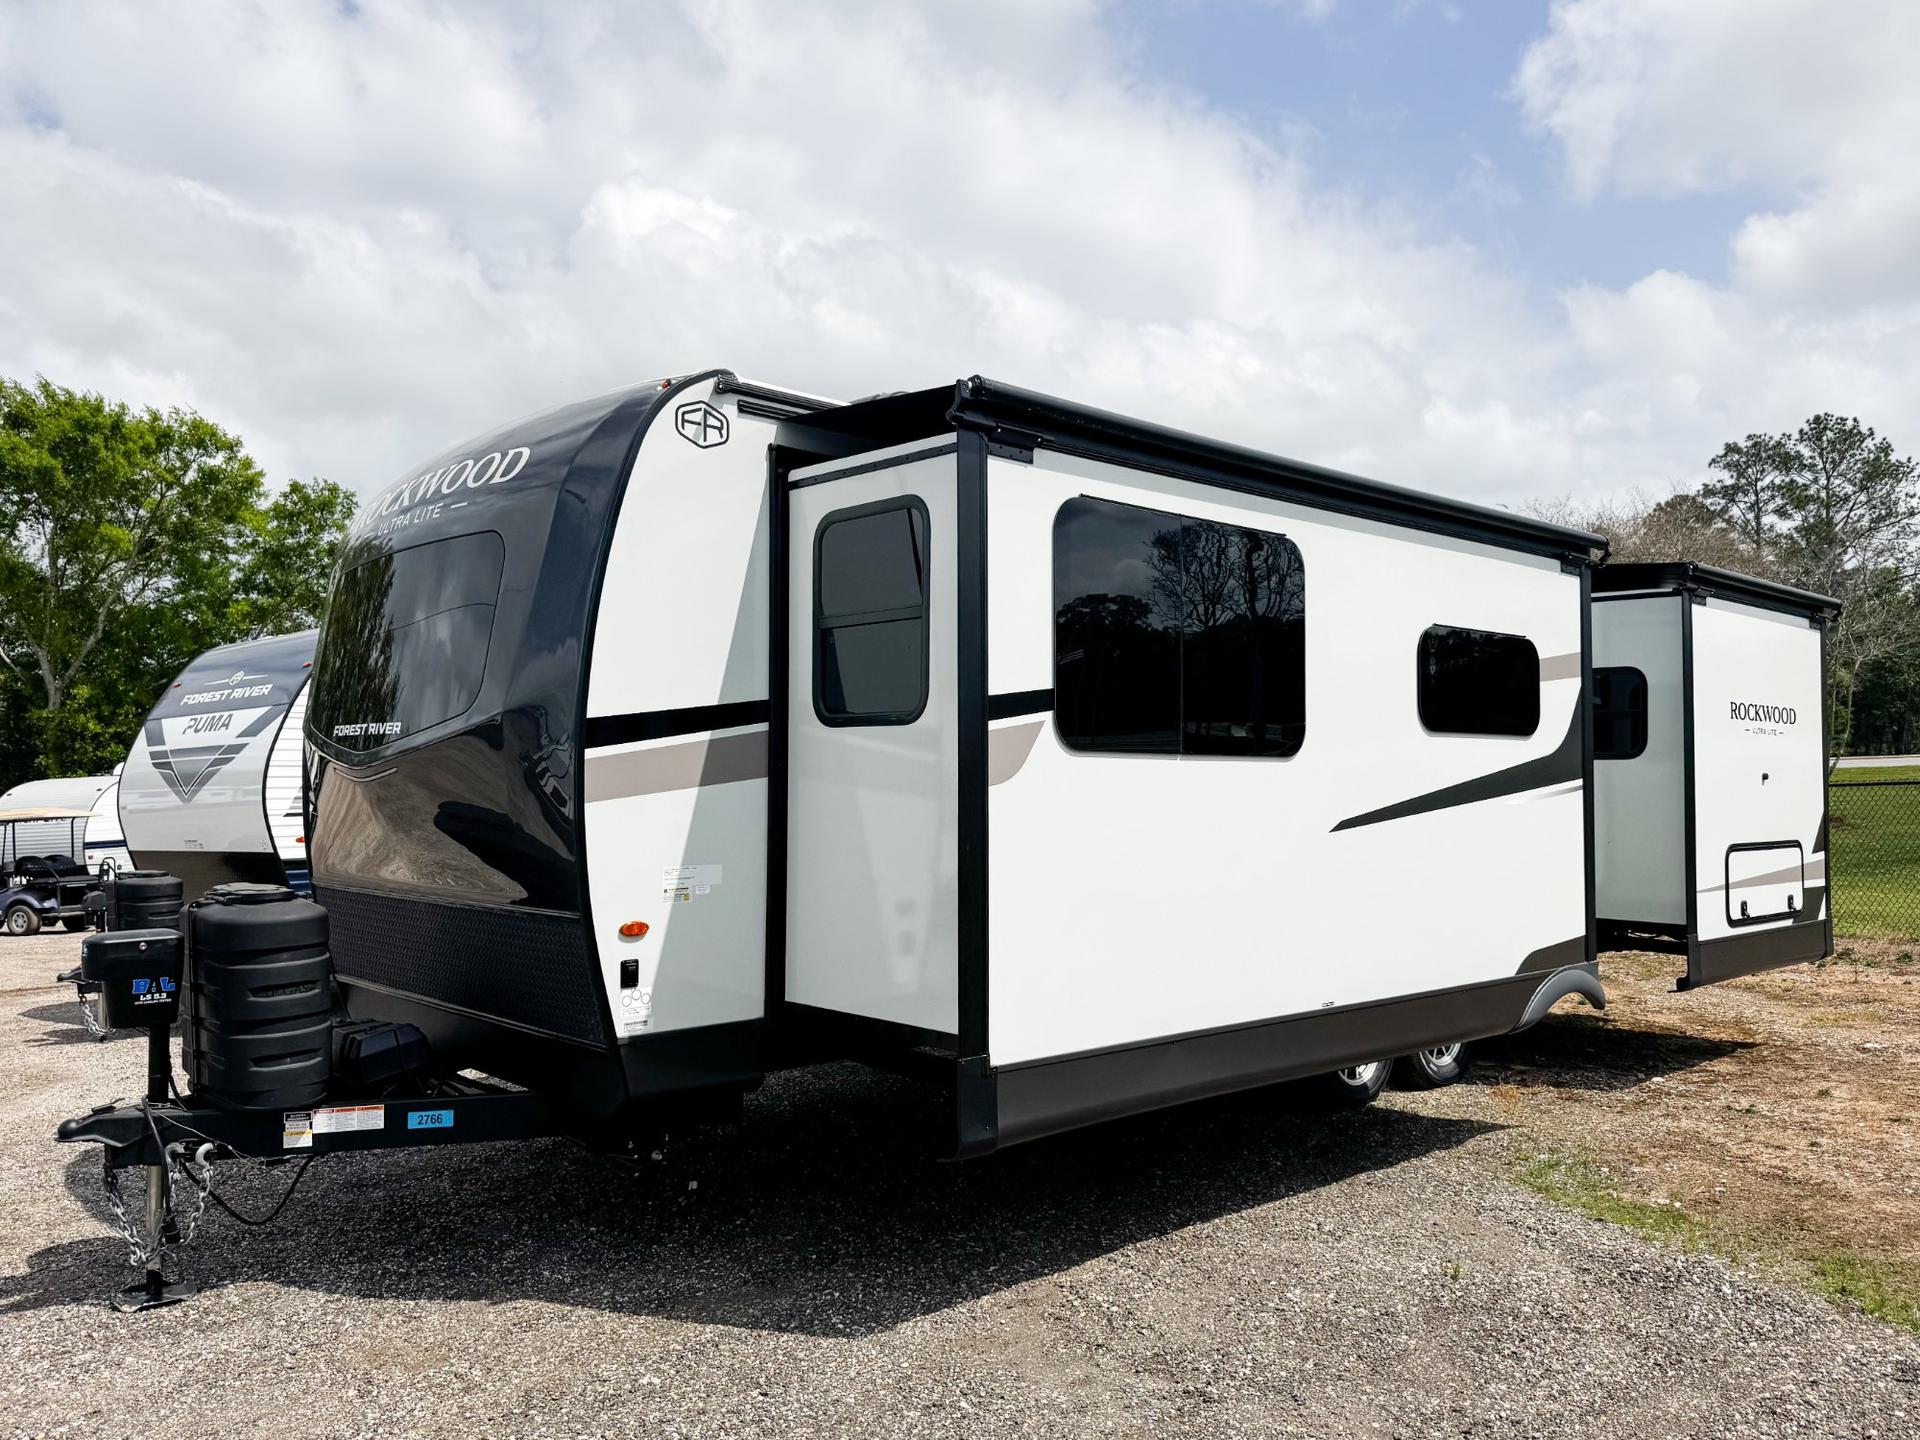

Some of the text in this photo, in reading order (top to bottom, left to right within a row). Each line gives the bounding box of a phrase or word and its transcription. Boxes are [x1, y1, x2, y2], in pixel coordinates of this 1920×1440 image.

[681, 407, 724, 442] FR
[349, 446, 531, 536] ROCKWOOD
[377, 502, 445, 536] ULTRA LITE
[180, 684, 273, 706] FOREST RIVER
[182, 713, 234, 735] PUMA
[1729, 701, 1797, 725] ROCKWOOD
[333, 721, 402, 737] FOREST RIVER
[417, 1113, 443, 1126] 2766
